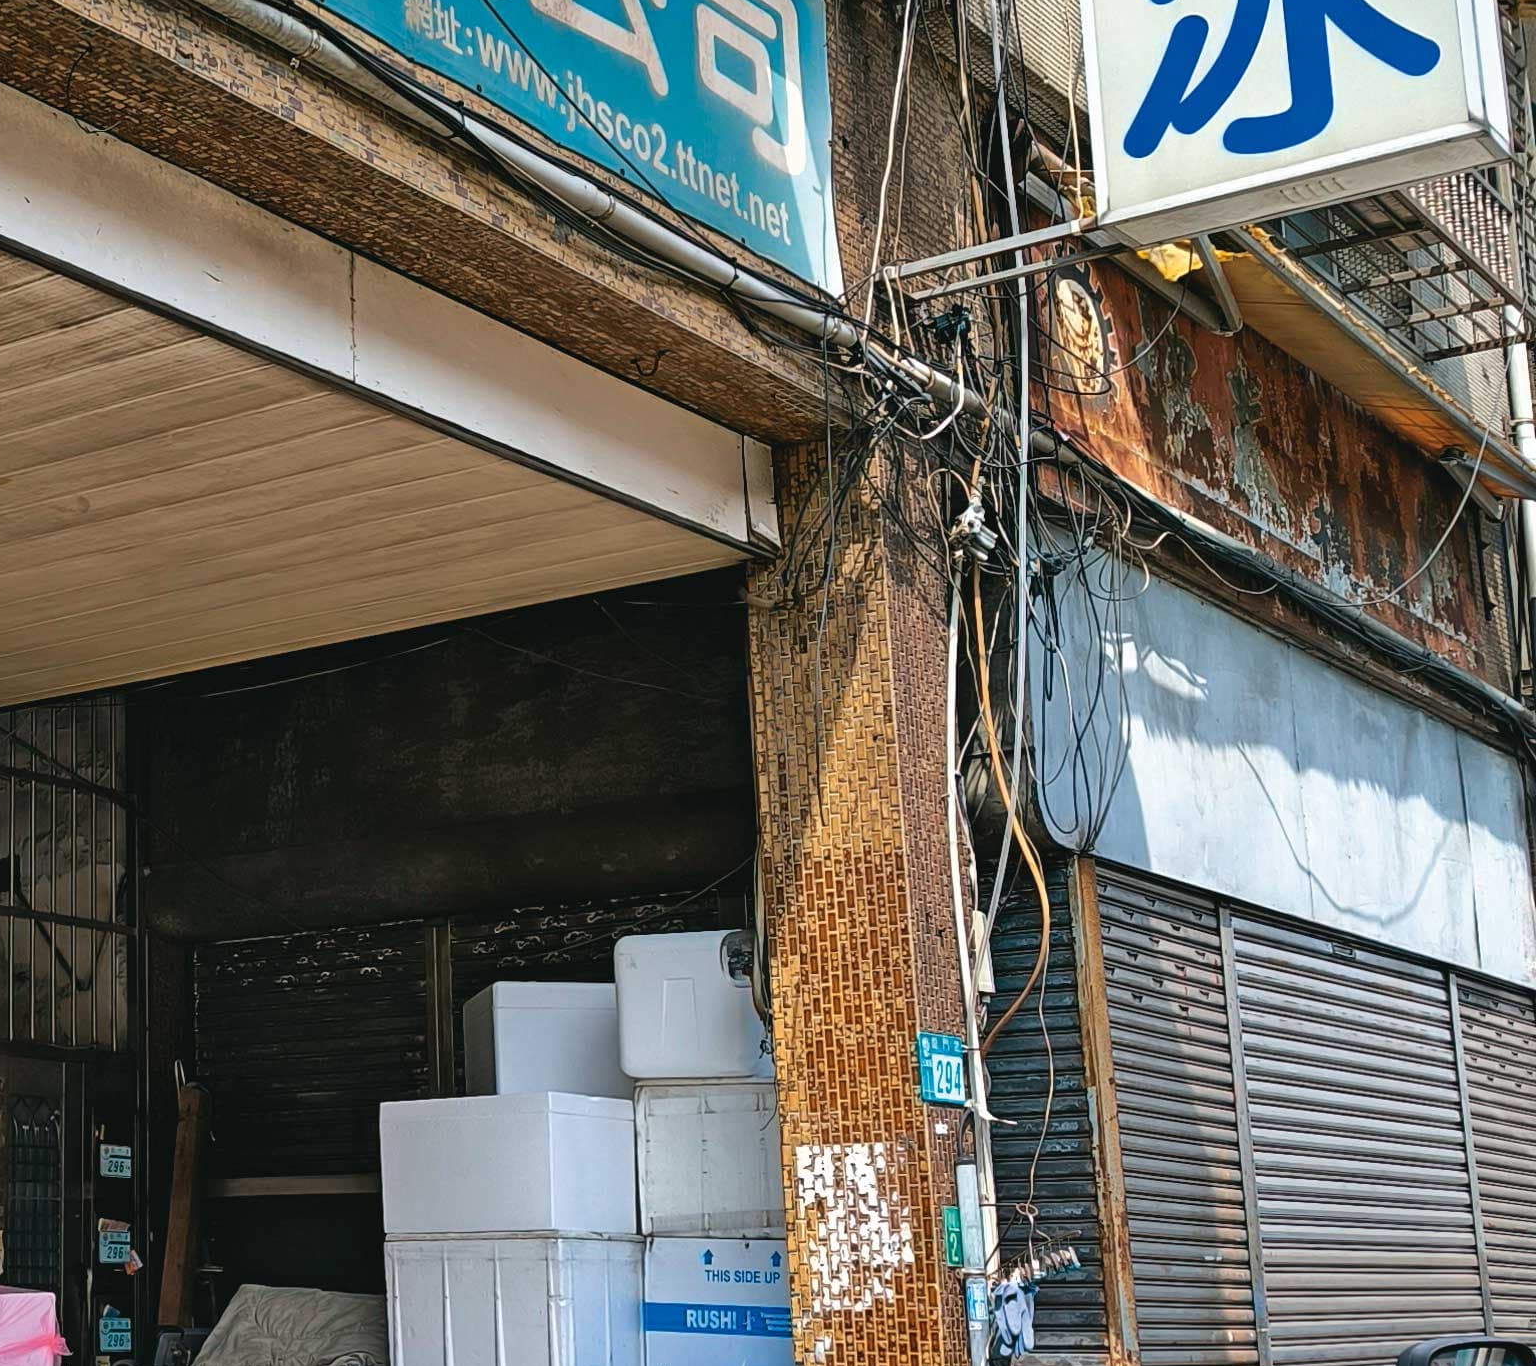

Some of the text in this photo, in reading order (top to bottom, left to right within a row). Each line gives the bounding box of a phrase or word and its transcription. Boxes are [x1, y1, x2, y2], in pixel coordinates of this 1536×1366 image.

[936, 1059, 962, 1096] 294
[107, 1159, 125, 1173] 296
[107, 1245, 124, 1259] 296
[705, 1269, 781, 1284] THIS SIDE UP
[686, 1309, 737, 1330] RUSH!
[107, 1334, 125, 1347] 296
